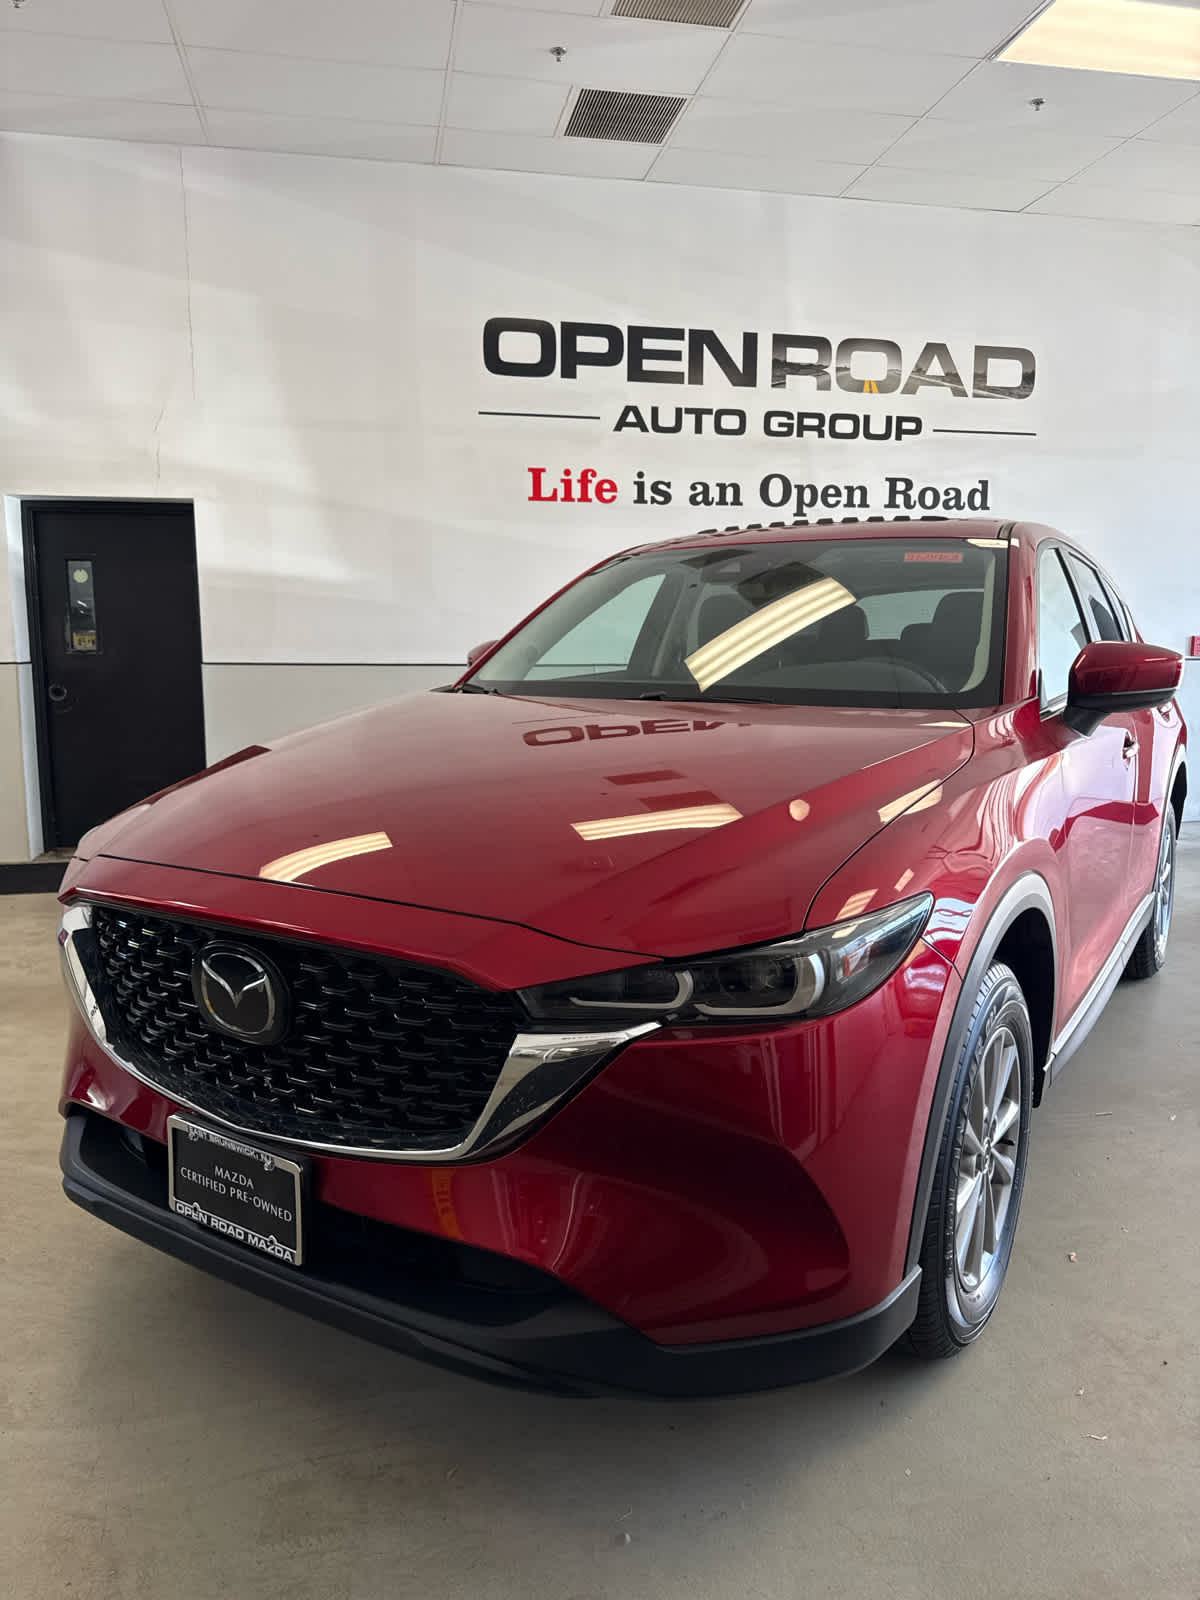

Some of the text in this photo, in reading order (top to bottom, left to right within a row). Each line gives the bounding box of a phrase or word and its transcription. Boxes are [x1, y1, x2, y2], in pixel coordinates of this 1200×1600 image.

[612, 405, 923, 441] AUTO GROUP
[527, 467, 991, 518] Life is an Open Road
[180, 1166, 292, 1222] CERTIFIED PRE-OWNED
[214, 1165, 255, 1190] MAZDA
[176, 1202, 293, 1263] OPEN ROAD MAZDA
